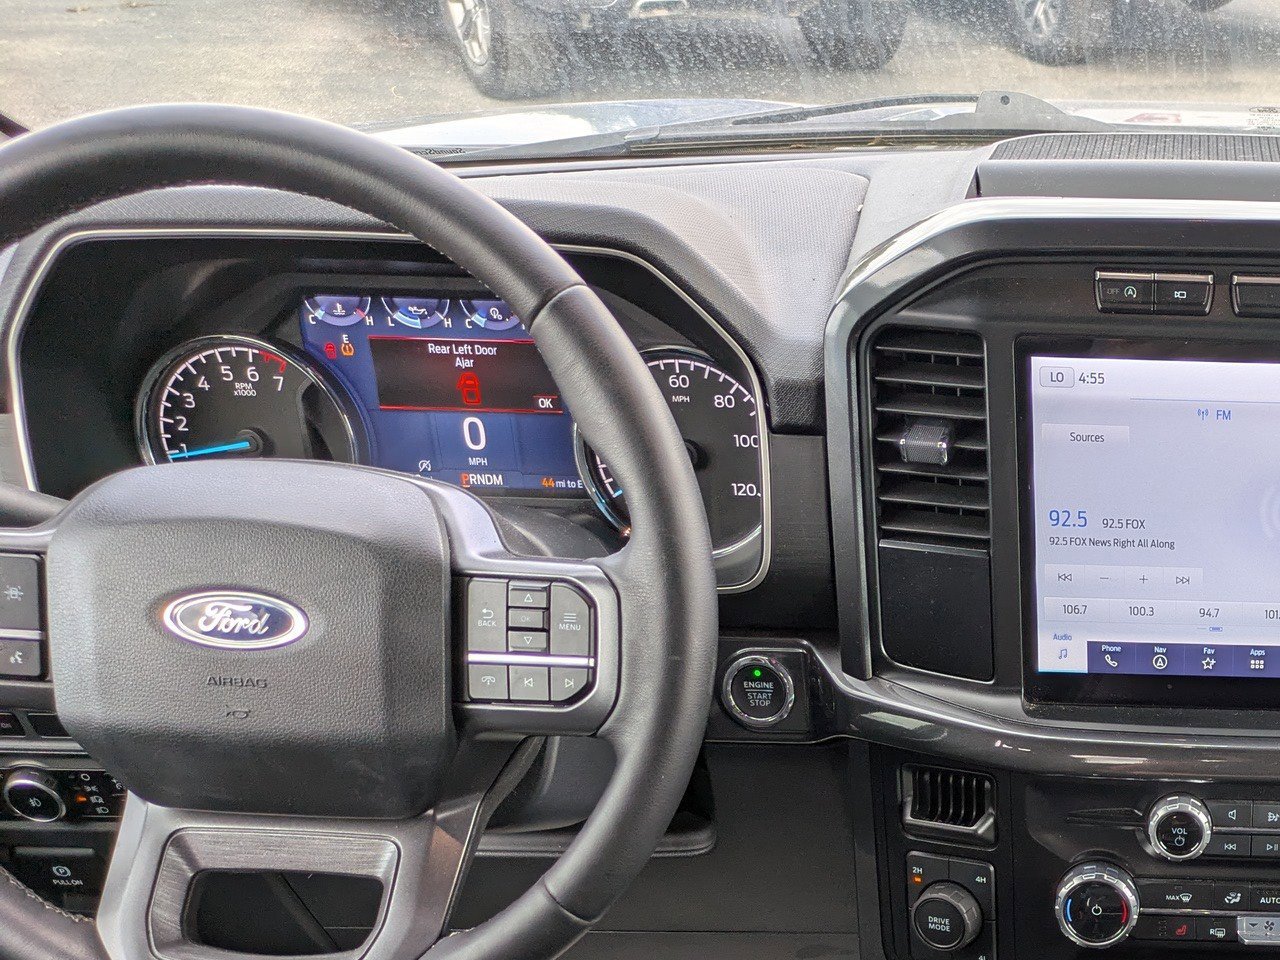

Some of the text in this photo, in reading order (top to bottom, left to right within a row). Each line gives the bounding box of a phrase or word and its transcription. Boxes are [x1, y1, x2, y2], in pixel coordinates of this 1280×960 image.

[309, 315, 316, 324] C
[366, 317, 374, 326] H
[388, 317, 394, 326] L
[444, 318, 452, 327] H
[466, 319, 472, 328] C
[343, 334, 349, 343] E
[429, 343, 497, 355] Rear Left Door
[455, 357, 474, 368] Ajar
[221, 366, 233, 381] 5
[247, 366, 259, 381] 6
[1050, 372, 1105, 384] LO 4:55
[197, 376, 210, 390] 4
[272, 376, 284, 391] 7
[668, 375, 689, 388] 60
[183, 393, 195, 408] 3
[538, 399, 553, 408] OK
[714, 395, 735, 408] 80
[1216, 410, 1231, 420] FM
[176, 416, 188, 431] 2
[463, 416, 486, 450] 0
[1070, 432, 1104, 442] Sources
[468, 457, 487, 466] MPH
[542, 478, 554, 487] 44
[567, 480, 576, 488] to
[577, 480, 583, 488] E
[731, 483, 757, 496] 120
[1049, 510, 1145, 529] 92.5 92.5 FOX
[1049, 536, 1175, 550] 92.5 FOX News Right All Along
[1062, 604, 1087, 614] 106.7
[1129, 606, 1154, 616] 100.3
[1199, 608, 1219, 618] 94.7
[198, 601, 270, 634] Ford
[1053, 633, 1072, 641] Audio
[1101, 644, 1121, 652] Phone
[206, 675, 267, 688] AIRBAG
[1171, 827, 1187, 835] VOL
[912, 866, 922, 874] 2H
[928, 915, 950, 925] DRIVE
[928, 923, 950, 932] MODE
